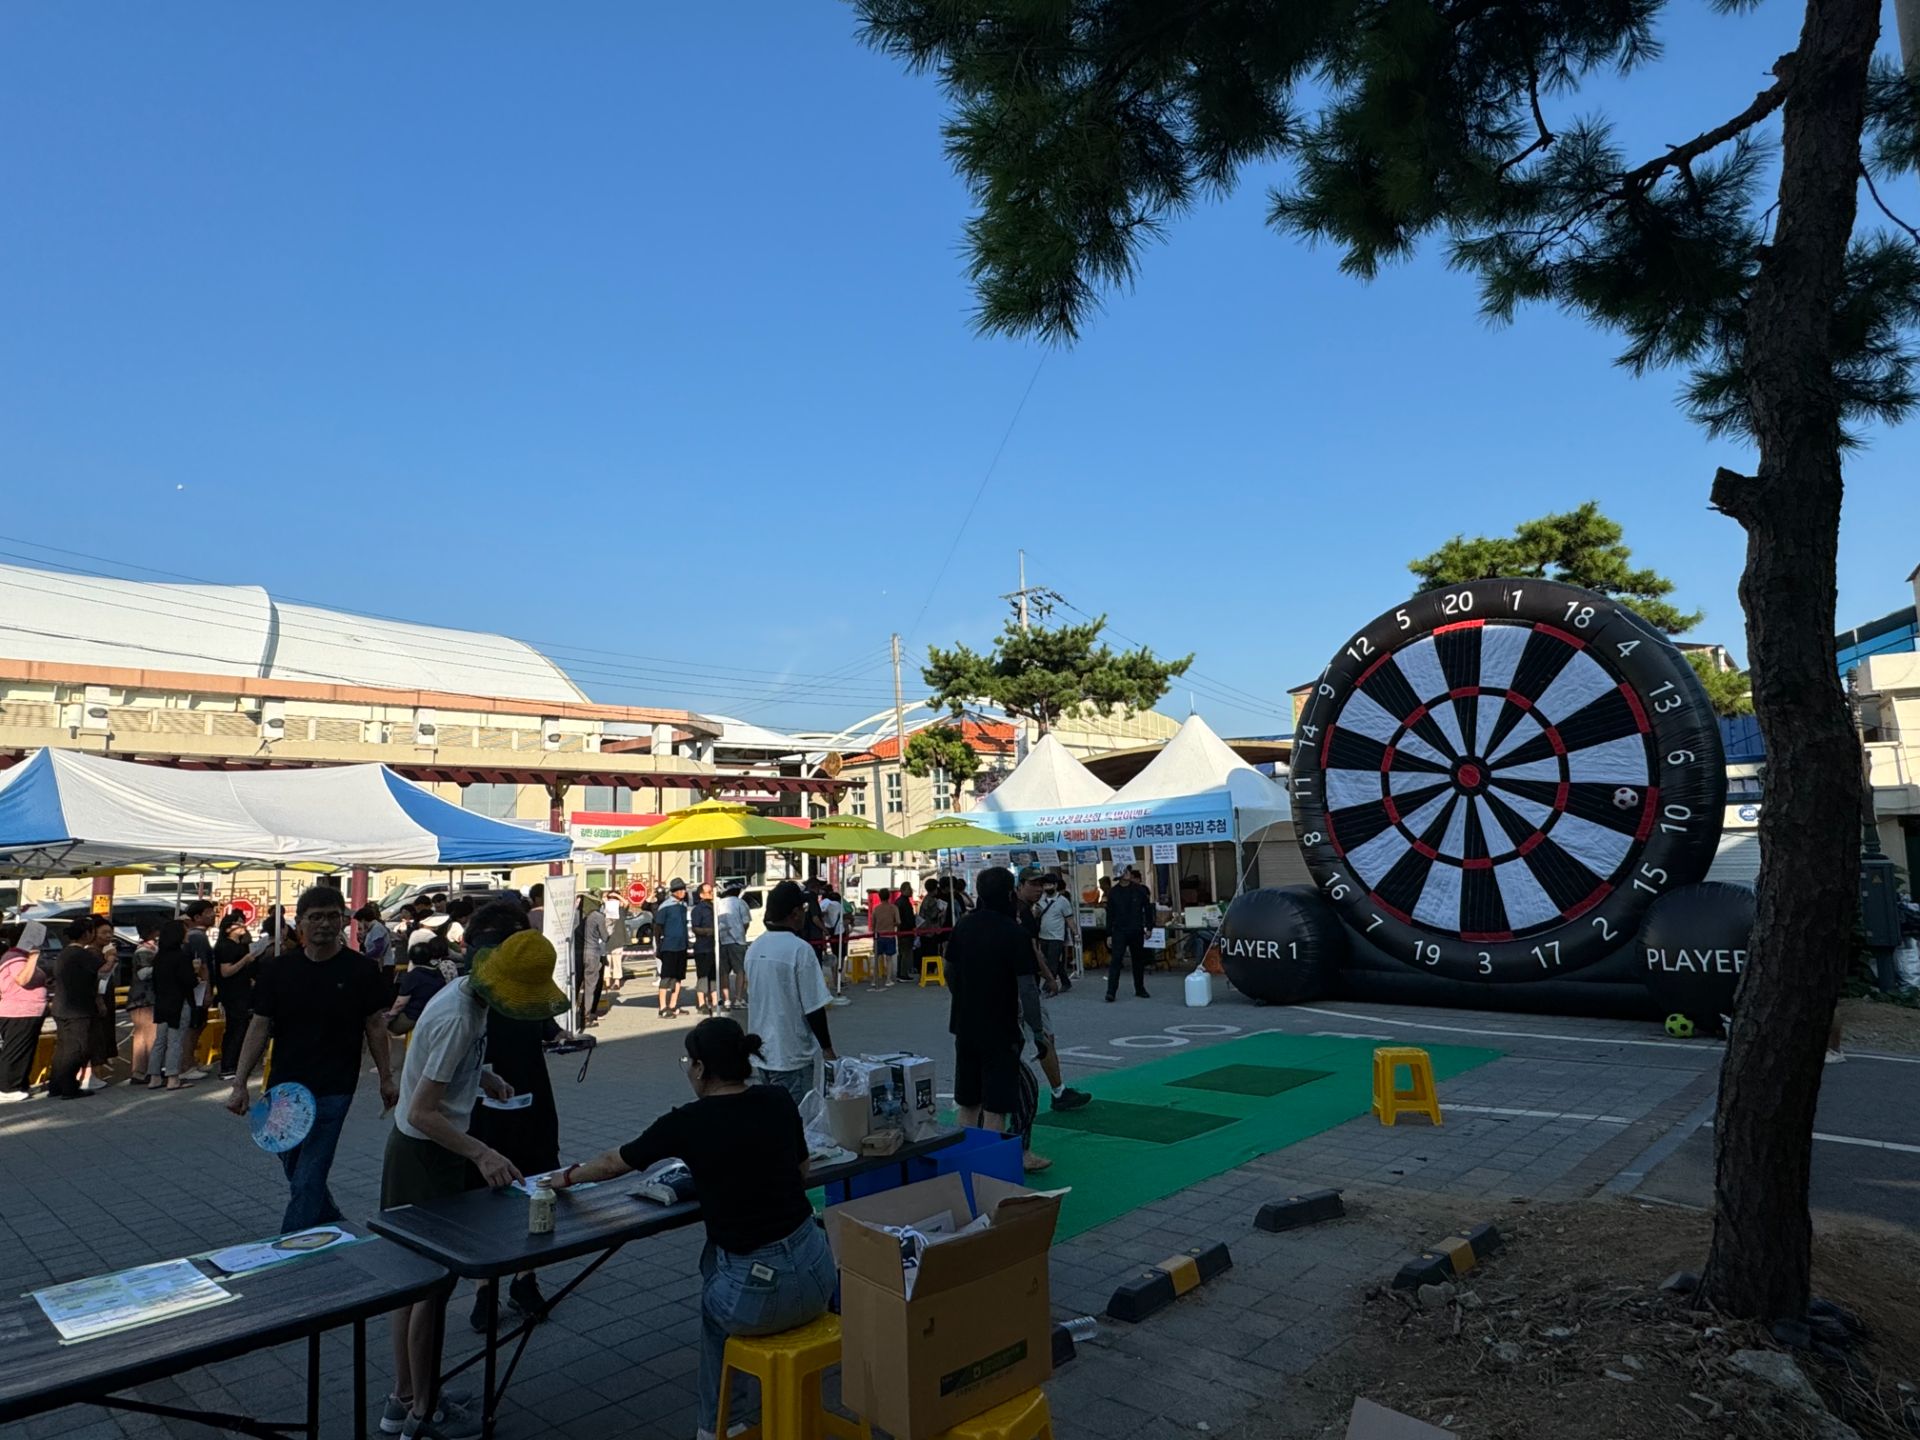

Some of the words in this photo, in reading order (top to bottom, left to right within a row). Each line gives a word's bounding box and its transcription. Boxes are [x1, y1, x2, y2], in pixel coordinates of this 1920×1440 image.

[1444, 591, 1473, 615] 20
[1511, 589, 1523, 611] 1
[1396, 609, 1411, 630] 5
[1564, 601, 1595, 628] 18
[1347, 636, 1375, 662] 12
[1617, 639, 1641, 658] 4
[1319, 683, 1335, 699] 9
[1649, 680, 1682, 713] 13
[1299, 723, 1319, 748] 14
[1667, 749, 1695, 765] 6
[1295, 777, 1312, 800] 11
[1109, 826, 1127, 840] 쿠폰
[1175, 820, 1204, 836] 입장권
[1206, 818, 1227, 833] 추첨
[1660, 804, 1692, 833] 10
[1303, 831, 1322, 847] 8
[1325, 871, 1350, 900] 16
[1633, 862, 1668, 894] 15
[1366, 913, 1384, 932] 7
[1591, 916, 1618, 941] 2
[1220, 937, 1281, 959] PLAYER
[1288, 941, 1297, 960] 1
[1413, 940, 1441, 966] 19
[1531, 940, 1562, 968] 17
[1478, 952, 1493, 975] 3
